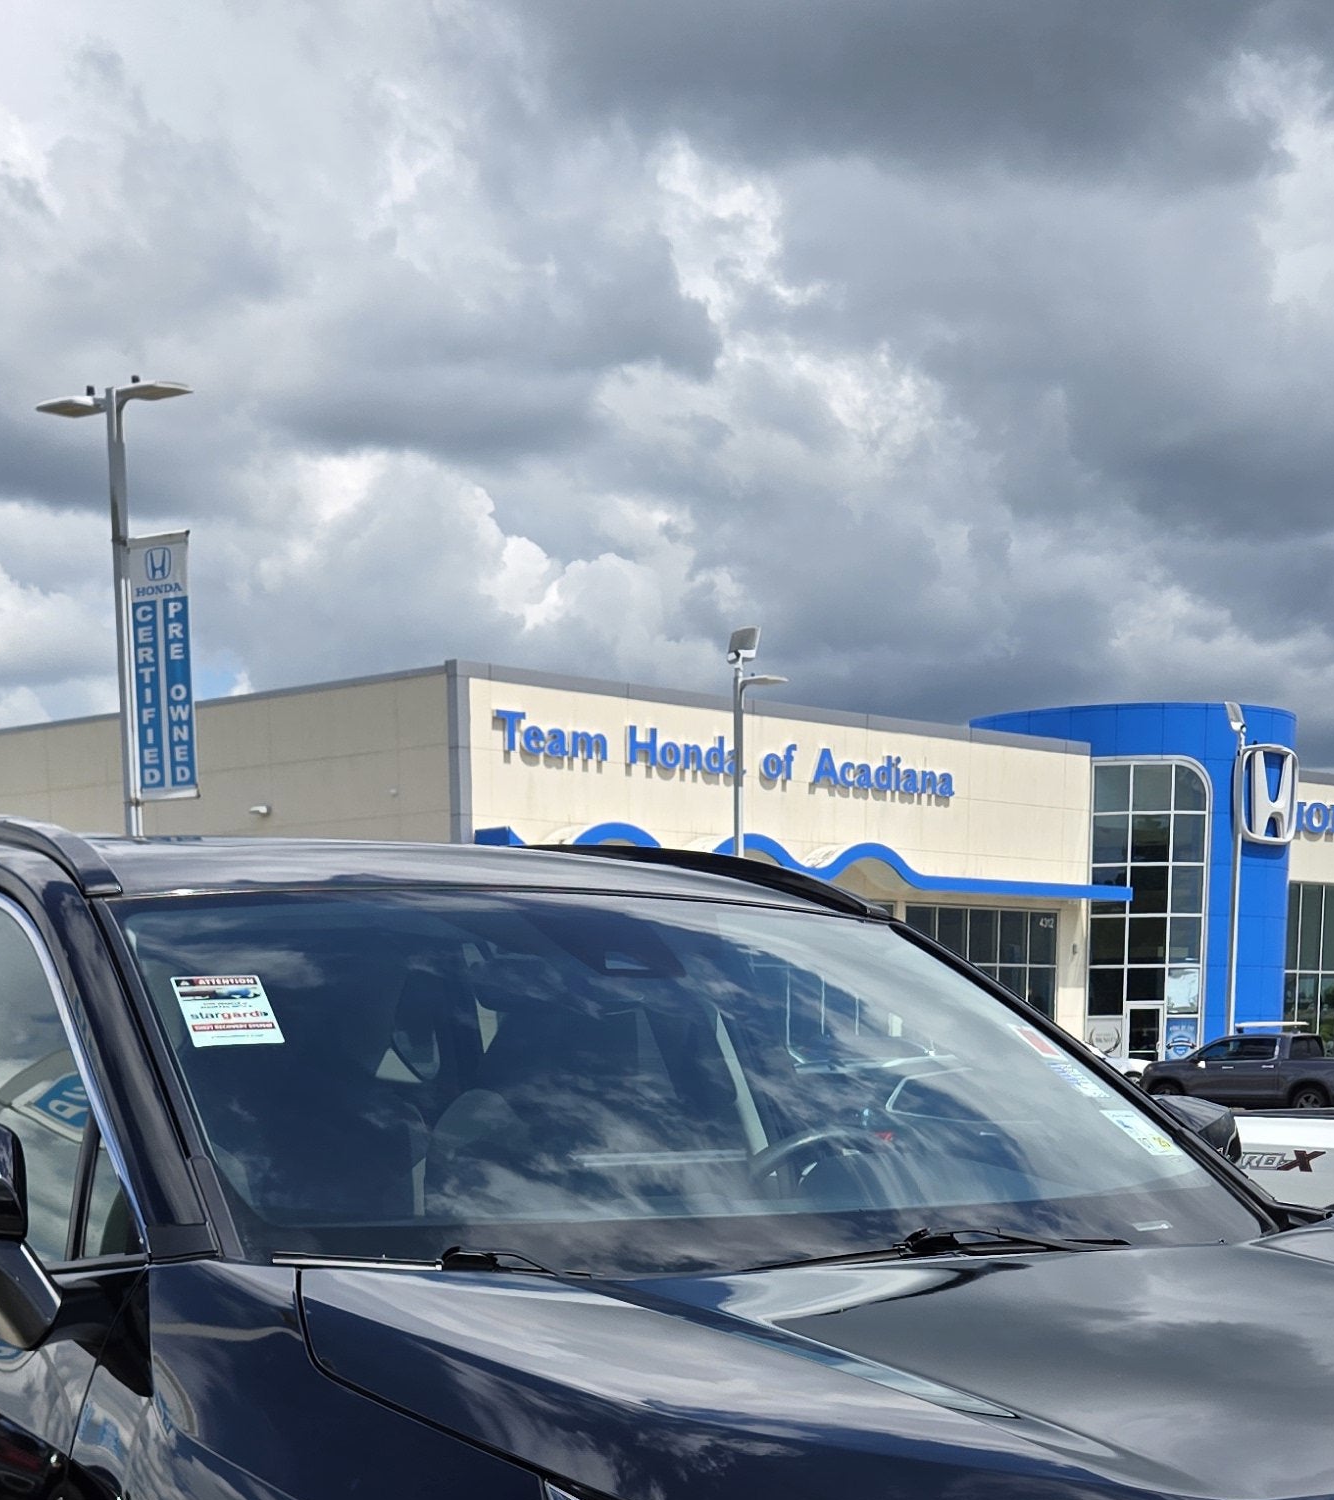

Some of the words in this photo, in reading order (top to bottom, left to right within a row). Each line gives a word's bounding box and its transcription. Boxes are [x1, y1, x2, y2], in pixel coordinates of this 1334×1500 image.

[135, 582, 183, 597] HONDA
[168, 601, 185, 660] PRE
[135, 605, 162, 785] CERTIFIED
[169, 683, 191, 783] OWNED
[495, 708, 608, 762] Team
[762, 743, 798, 781] of
[813, 747, 955, 797] Acadiana
